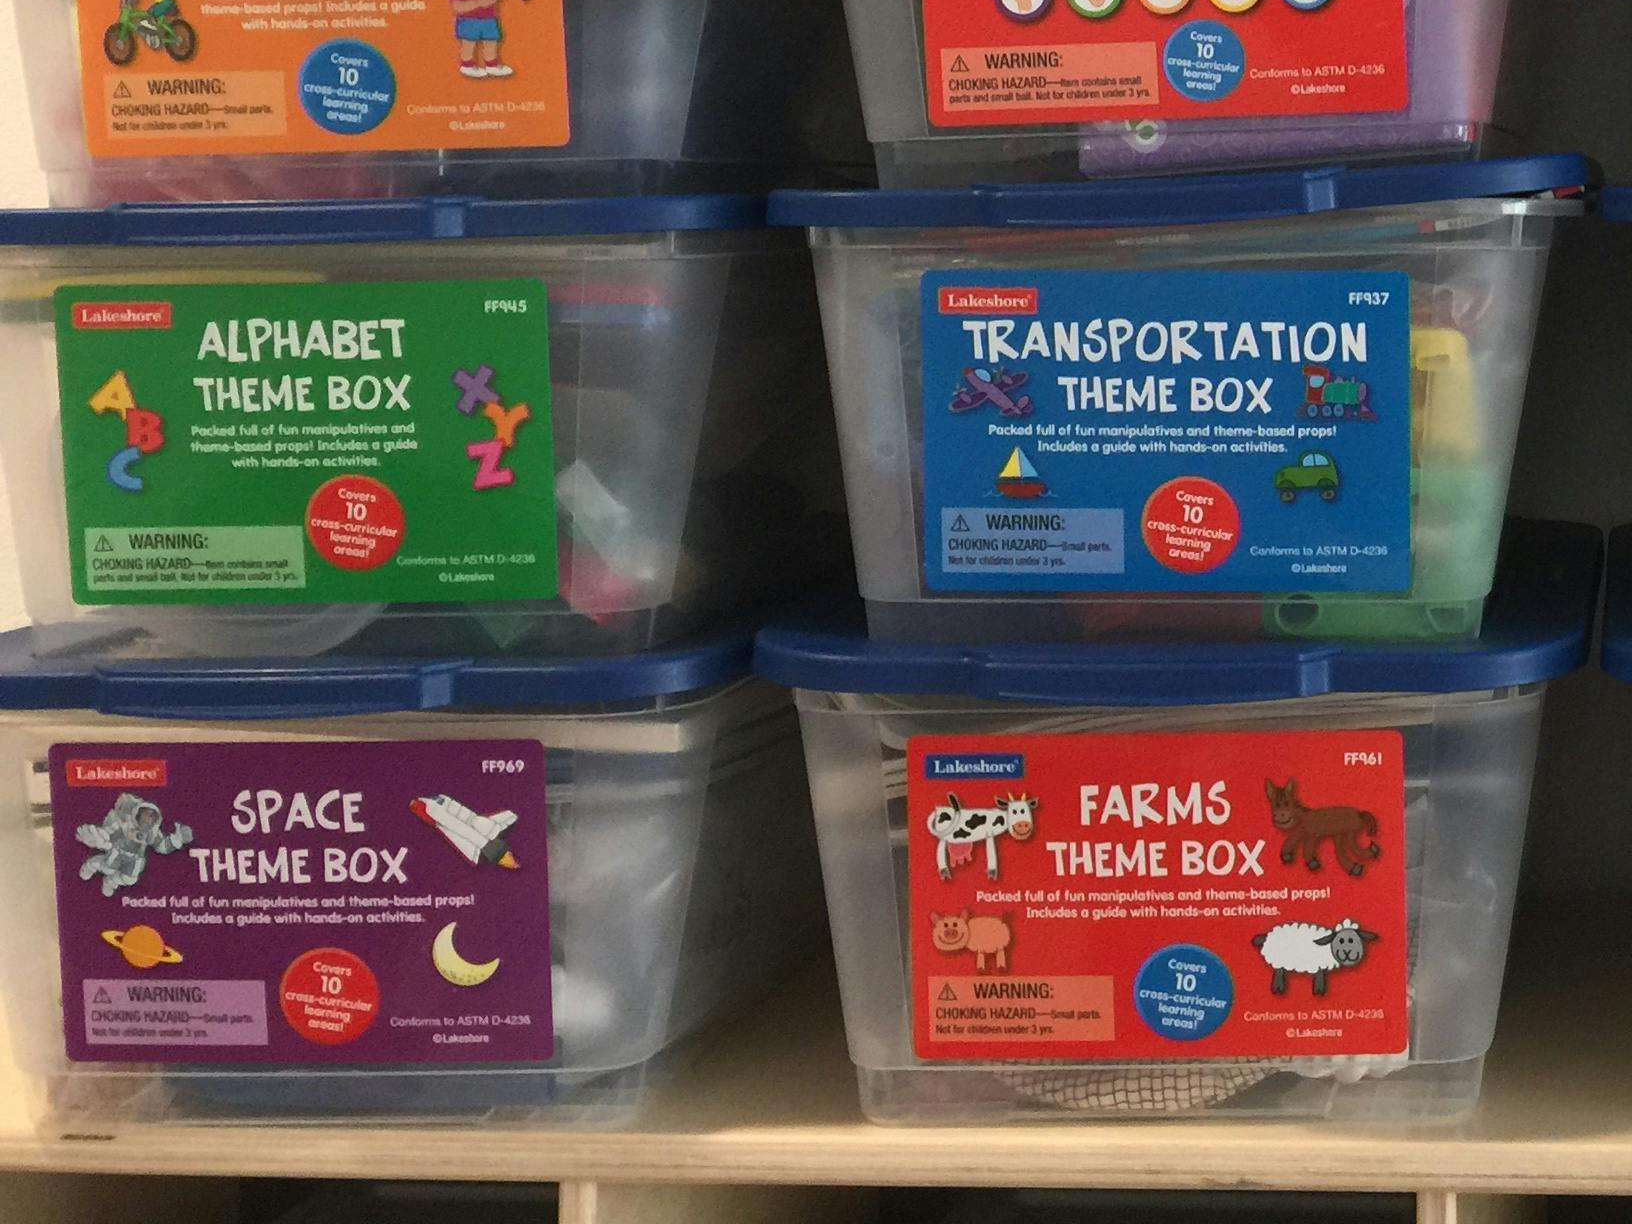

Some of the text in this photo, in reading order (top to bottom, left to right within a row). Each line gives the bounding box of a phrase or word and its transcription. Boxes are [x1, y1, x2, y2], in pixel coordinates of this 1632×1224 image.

[984, 53, 1063, 69] WARNING:
[1250, 67, 1298, 79] Conforms
[1302, 66, 1310, 77] to
[1313, 66, 1345, 77] ASTM
[147, 78, 226, 96] WARNING:
[484, 300, 527, 313] FF945
[947, 294, 1028, 308] Lakeshore
[1349, 292, 1389, 305] FF937
[82, 309, 161, 323] Lakeshore
[198, 319, 405, 362] ALPHABET
[962, 319, 1367, 364] TRANSPORTATION
[88, 369, 135, 420] A
[194, 374, 411, 413] THEME BOX
[452, 364, 499, 414] X
[1058, 377, 1273, 414] THEME BOX
[126, 408, 165, 452] B
[484, 402, 530, 447] Y
[988, 424, 1336, 442] Packed full of fun manipulatives and theme-based props!
[106, 445, 142, 492] C
[467, 439, 515, 490] Z
[1175, 491, 1214, 506] Covers
[986, 515, 1065, 531] WARNING:
[1183, 505, 1204, 523] 10
[1147, 521, 1233, 542] cross-curricular
[129, 533, 208, 550] WARNING:
[1165, 533, 1211, 553] learning
[1169, 548, 1204, 562] areas!
[482, 760, 524, 773] FF969
[934, 760, 1015, 775] Lakeshore
[1344, 752, 1383, 766] FF961
[76, 766, 157, 781] Lakeshore
[231, 789, 365, 834] SPACE
[1080, 781, 1231, 829] FARMS
[189, 847, 408, 883] THEME BOX
[1046, 840, 1266, 877] THEME BOX
[127, 986, 206, 1003] WARNING:
[974, 983, 1054, 1000] WARNING:
